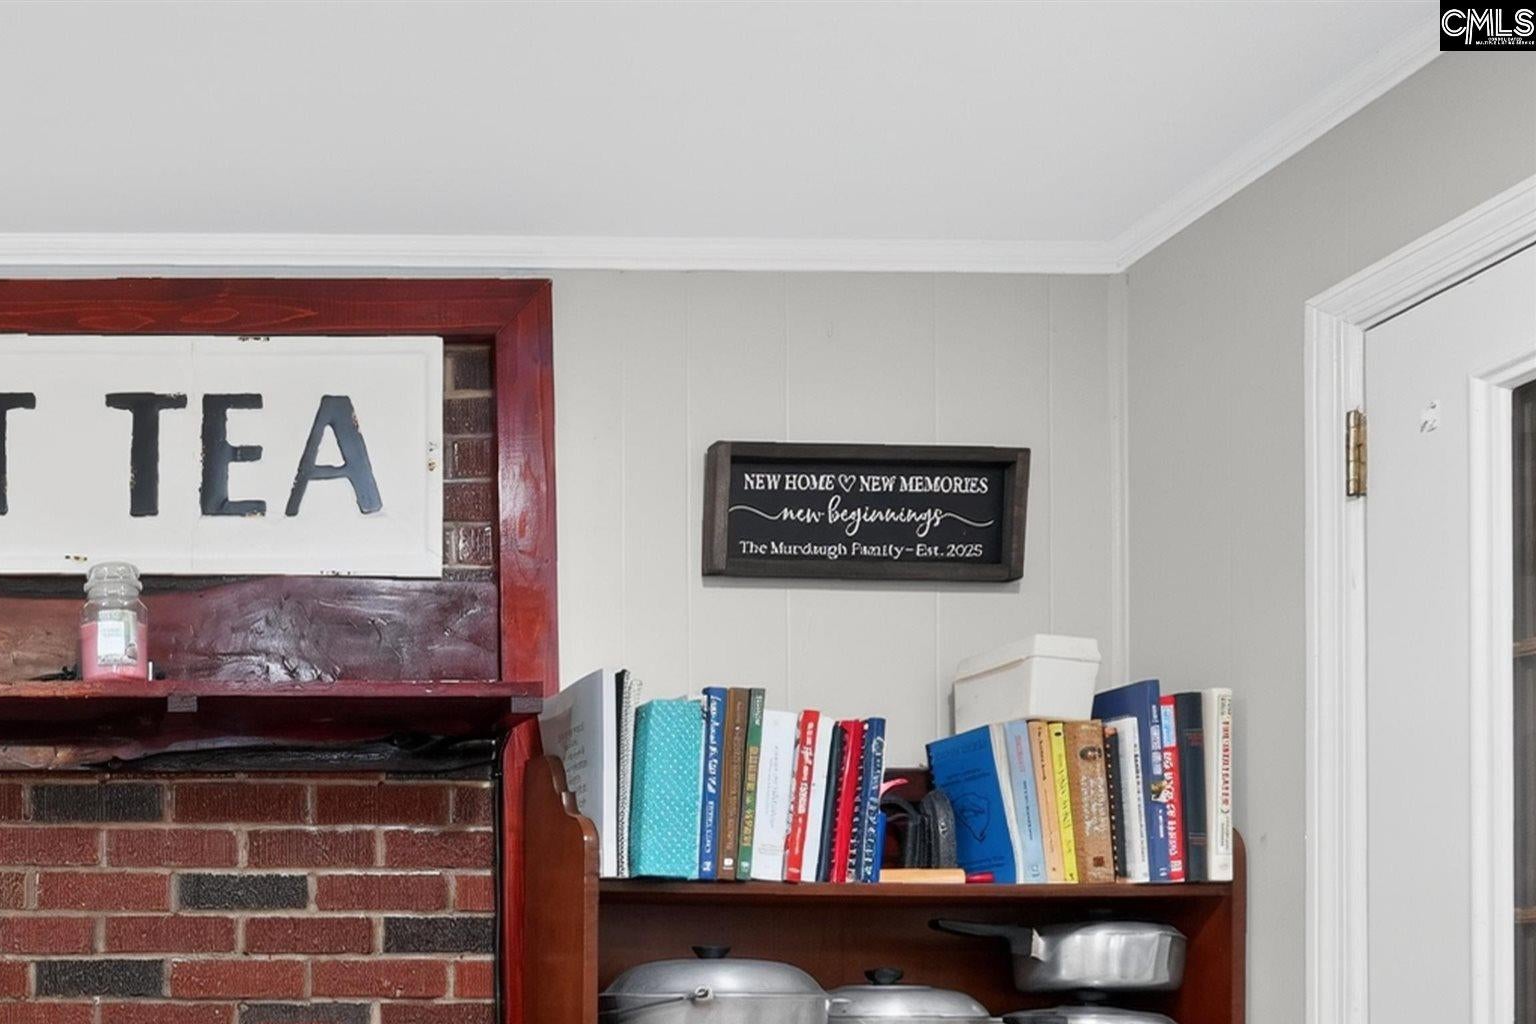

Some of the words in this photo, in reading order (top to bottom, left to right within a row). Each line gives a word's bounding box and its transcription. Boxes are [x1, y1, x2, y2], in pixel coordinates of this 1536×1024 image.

[105, 391, 384, 518] TEA
[744, 473, 781, 491] NEW
[784, 474, 836, 491] HOME
[859, 475, 897, 493] NEW
[899, 475, 989, 494] MEMORIES
[781, 507, 825, 524] new
[828, 494, 944, 538] beginnings
[739, 540, 768, 555] The
[946, 543, 984, 558] 2025
